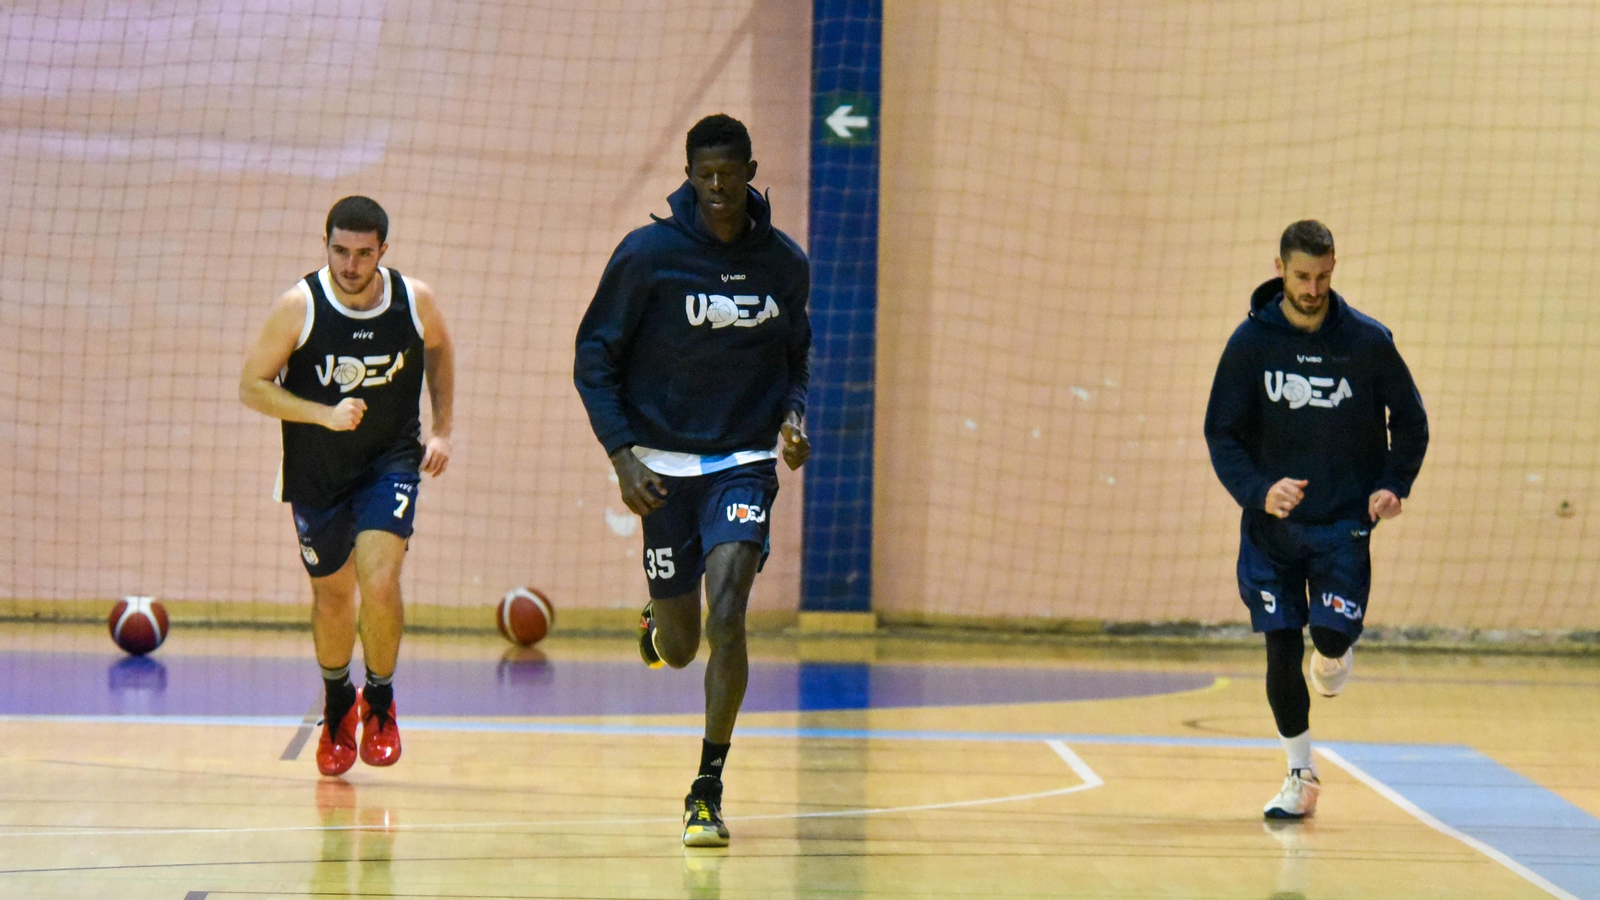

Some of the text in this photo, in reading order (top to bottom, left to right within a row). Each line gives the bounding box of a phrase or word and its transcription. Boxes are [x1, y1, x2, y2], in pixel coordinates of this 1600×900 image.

[685, 293, 780, 329] UDEA
[315, 351, 405, 393] UDEA
[1264, 370, 1353, 409] UDEA
[393, 492, 408, 519] 7
[646, 547, 675, 579] 35
